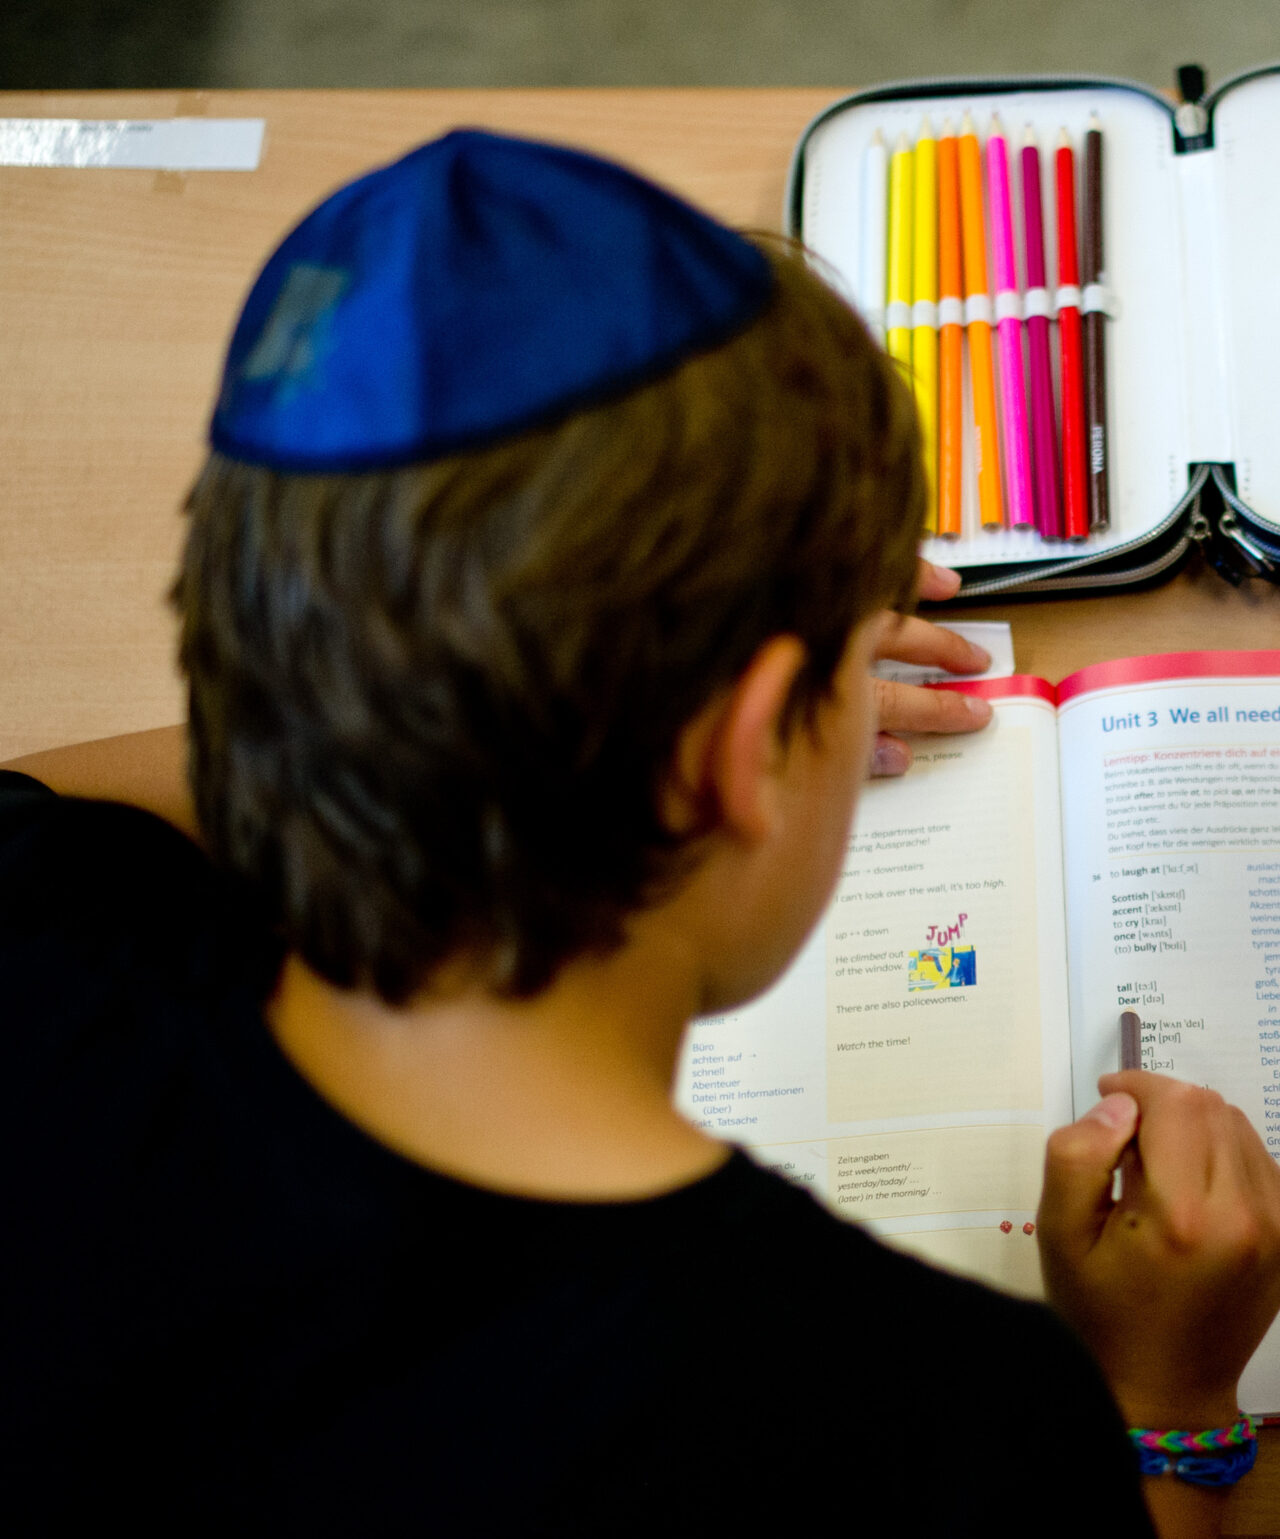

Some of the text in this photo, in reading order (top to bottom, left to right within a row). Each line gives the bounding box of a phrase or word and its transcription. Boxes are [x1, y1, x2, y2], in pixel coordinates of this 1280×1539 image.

[1093, 426, 1103, 474] PERONA
[1102, 715, 1140, 732] Unit
[1148, 712, 1158, 727] 3
[1170, 708, 1200, 724] We
[1207, 707, 1229, 723] all
[1122, 866, 1148, 877] laugh
[1112, 892, 1149, 903] Scottish
[1112, 907, 1142, 915] accent
[926, 913, 968, 946] JUMP
[1125, 920, 1139, 928] cry
[1114, 933, 1135, 941] once
[1134, 943, 1157, 952] bully
[1118, 983, 1132, 992] tall
[1118, 996, 1140, 1005] Dear
[837, 1005, 862, 1014] There
[882, 1001, 900, 1010] also
[837, 1042, 866, 1052] Watch
[886, 1037, 910, 1047] time!
[738, 1086, 804, 1099] Informationen
[838, 1153, 889, 1164] Zeitangaben
